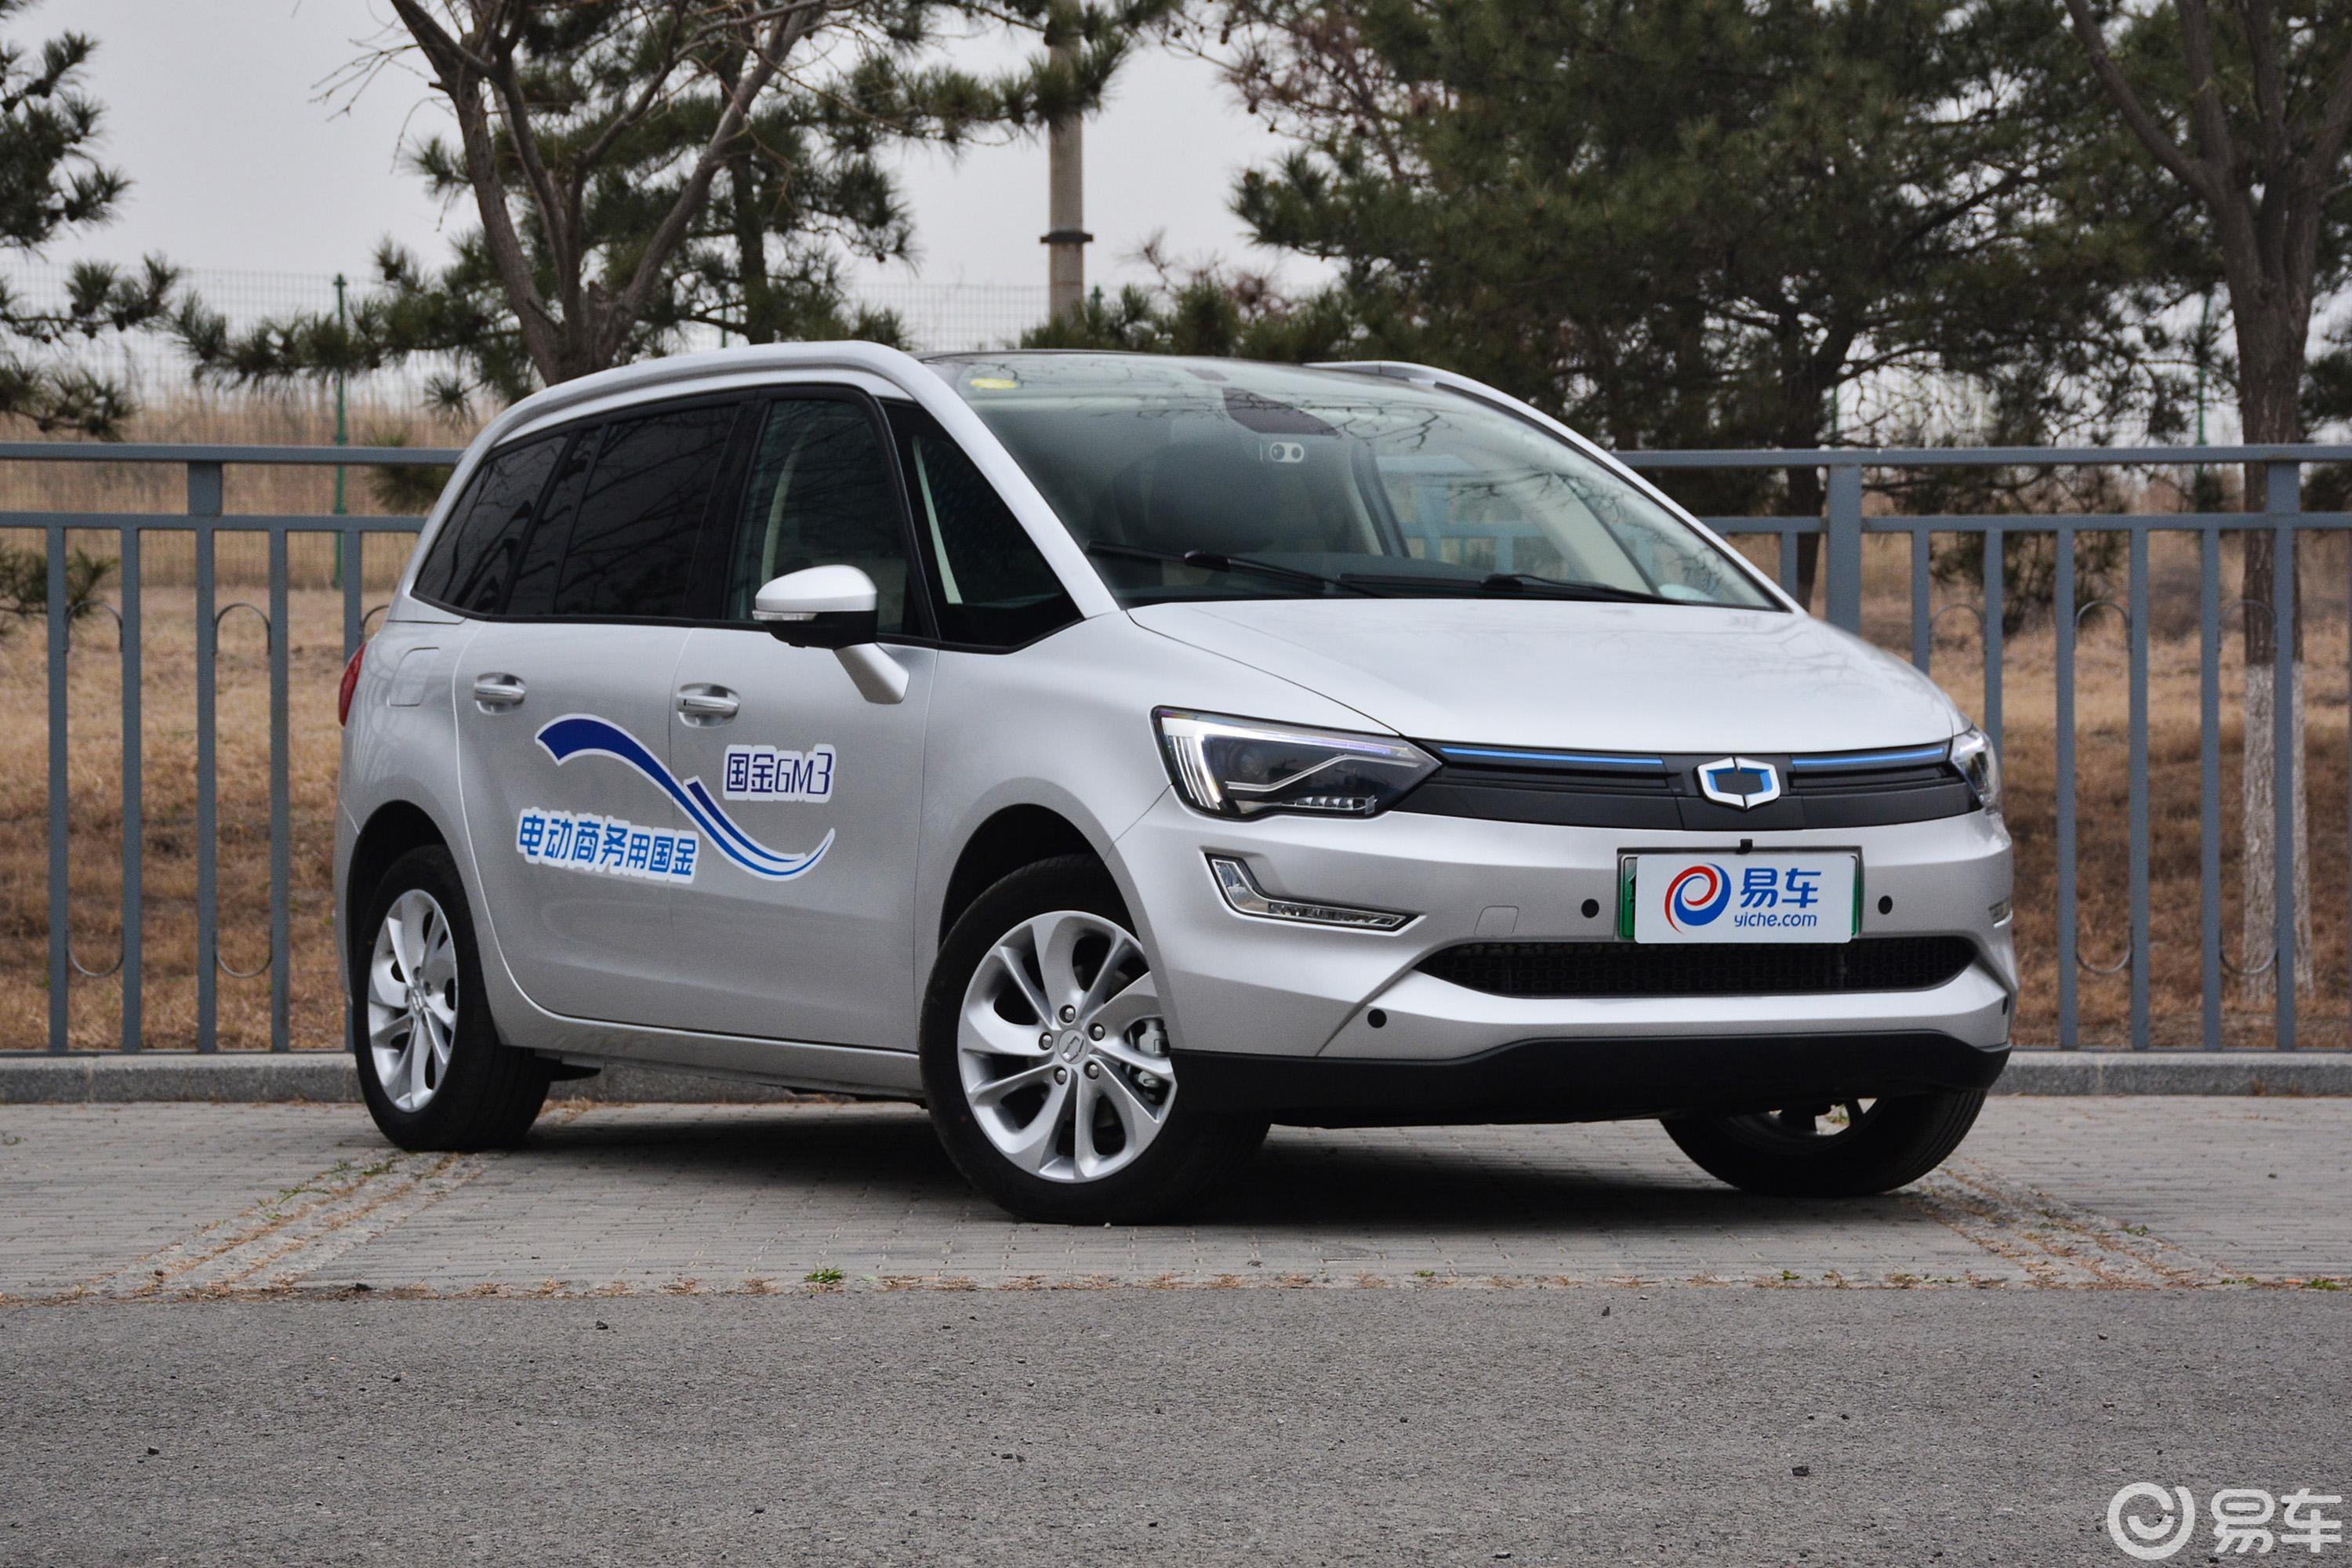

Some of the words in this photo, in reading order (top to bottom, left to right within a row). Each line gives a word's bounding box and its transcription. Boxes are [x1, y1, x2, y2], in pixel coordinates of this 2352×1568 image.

[727, 752, 833, 794] 国金GM3
[518, 815, 697, 876] 电动商务用国金
[1740, 867, 1821, 909] 易车
[1734, 912, 1817, 927] yiche.com
